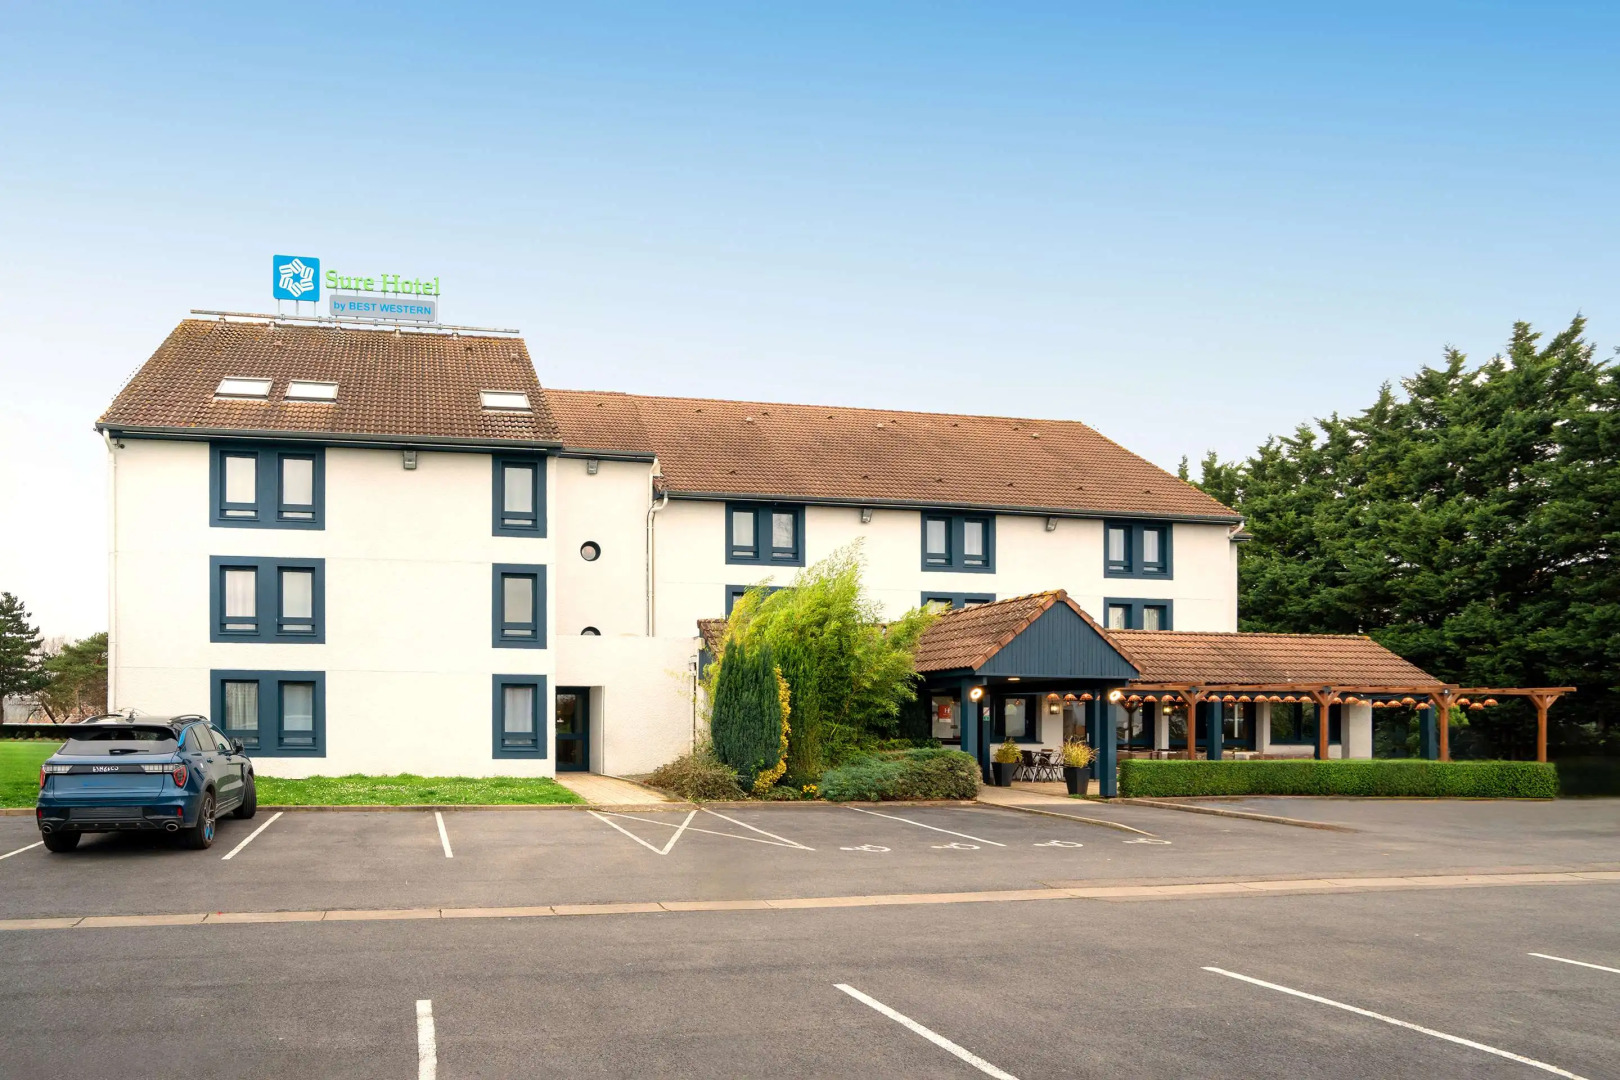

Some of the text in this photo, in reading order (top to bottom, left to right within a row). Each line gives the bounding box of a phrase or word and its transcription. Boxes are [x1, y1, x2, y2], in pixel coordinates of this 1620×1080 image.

[325, 269, 440, 295] Sure Hotel
[334, 302, 431, 314] by BEST WESTERN
